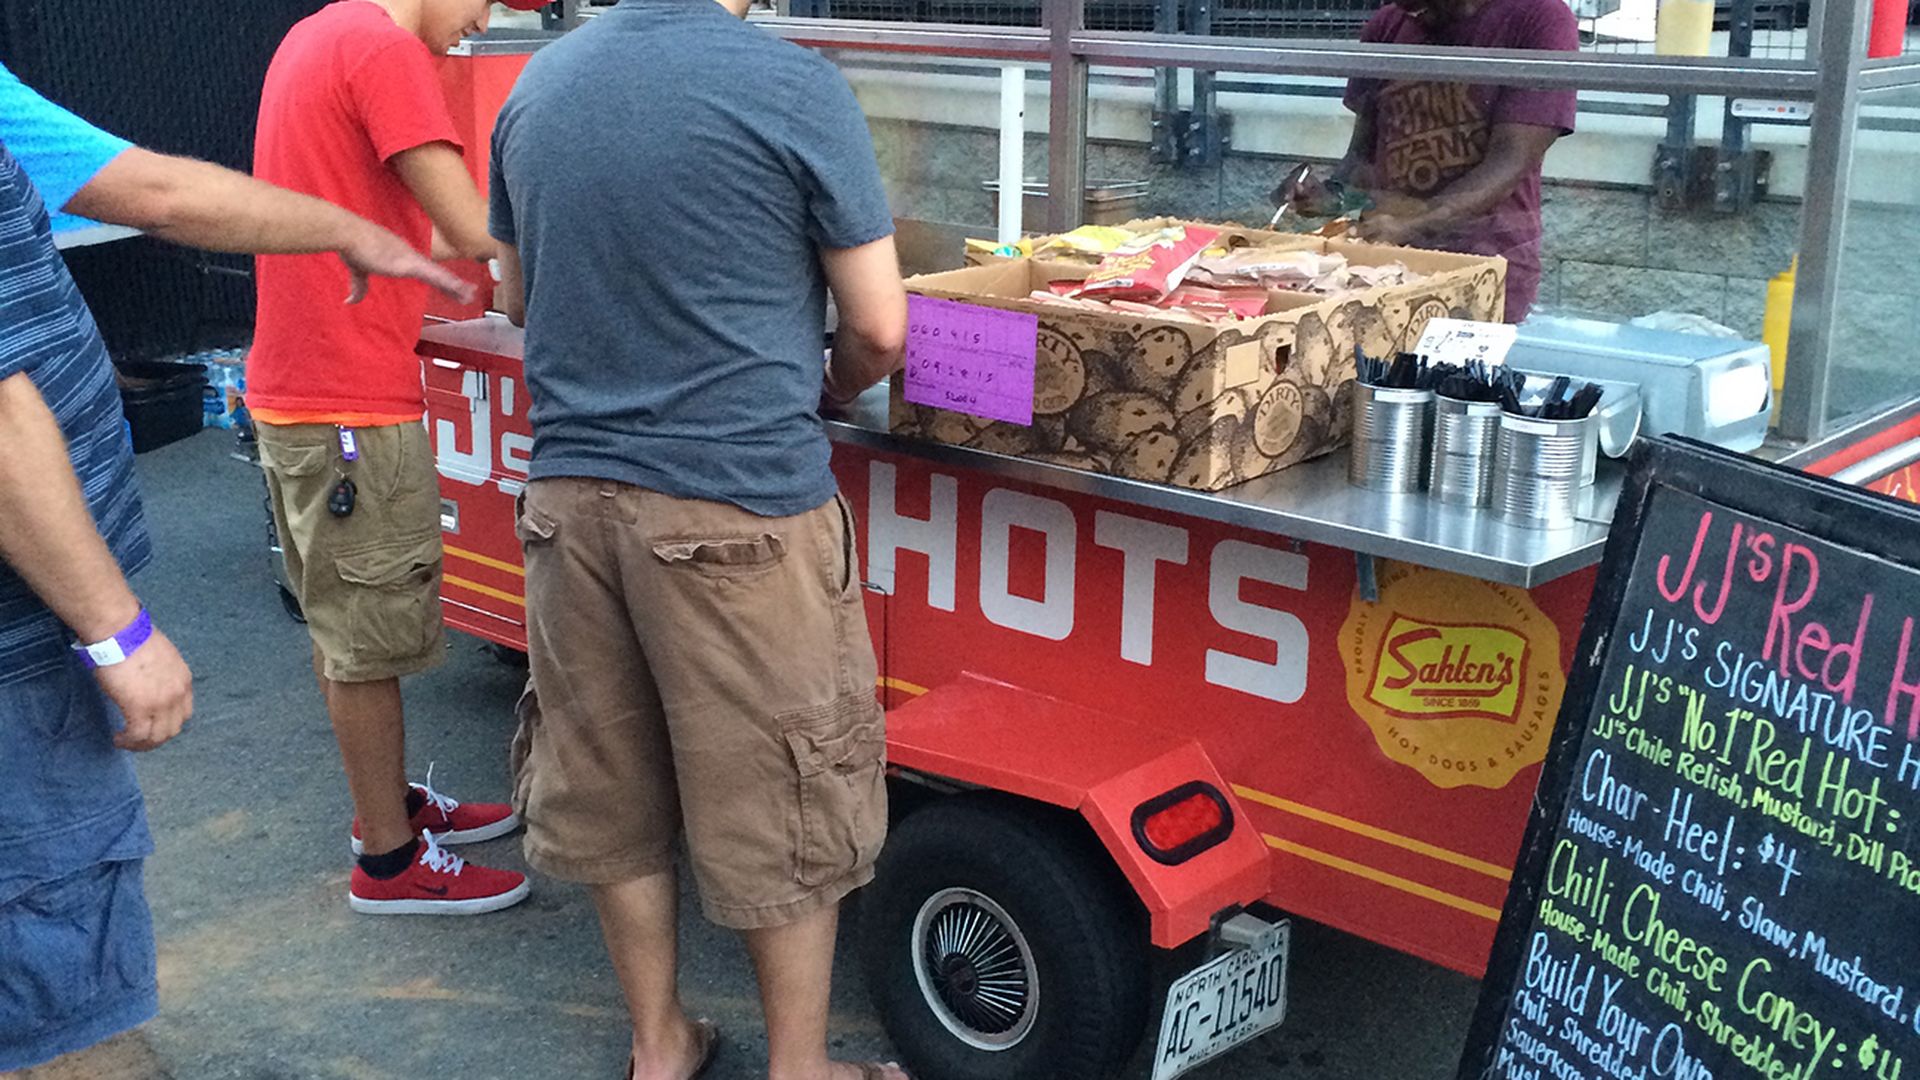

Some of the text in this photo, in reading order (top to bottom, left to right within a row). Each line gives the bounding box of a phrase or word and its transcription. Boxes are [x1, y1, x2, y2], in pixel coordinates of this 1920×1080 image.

[1259, 386, 1301, 417] DIRTY
[867, 459, 1311, 704] HOTS
[1656, 511, 1776, 625] JJ's
[1761, 542, 1874, 704] Red
[1382, 627, 1515, 687] Sahlen's
[1704, 641, 1893, 769] SIGNATURE
[1387, 726, 1420, 756] HOT
[1428, 753, 1479, 773] DOGS
[1504, 670, 1550, 759] SAUSAGES
[1744, 718, 1812, 799] Red
[1815, 750, 1901, 834] Hot:
[1625, 727, 1673, 767] Chile
[1676, 750, 1749, 809] Relish,
[1752, 786, 1843, 857] Mustard,
[1846, 832, 1885, 873] Dill
[1567, 808, 1676, 885] House-Made
[1681, 869, 1731, 922] Chili,
[1738, 896, 1798, 958] Slaw,
[1757, 832, 1802, 896] $4
[1162, 953, 1284, 1064] AC-11540
[1173, 969, 1222, 1006] NORTH
[1525, 932, 1596, 1016] Build
[1596, 974, 1651, 1056] Your
[1539, 899, 1641, 979] House-Made
[1646, 967, 1692, 1023] Chili,
[1547, 839, 1615, 925] Chili
[1622, 883, 1728, 993] Cheese
[1737, 957, 1848, 1080] Coney:
